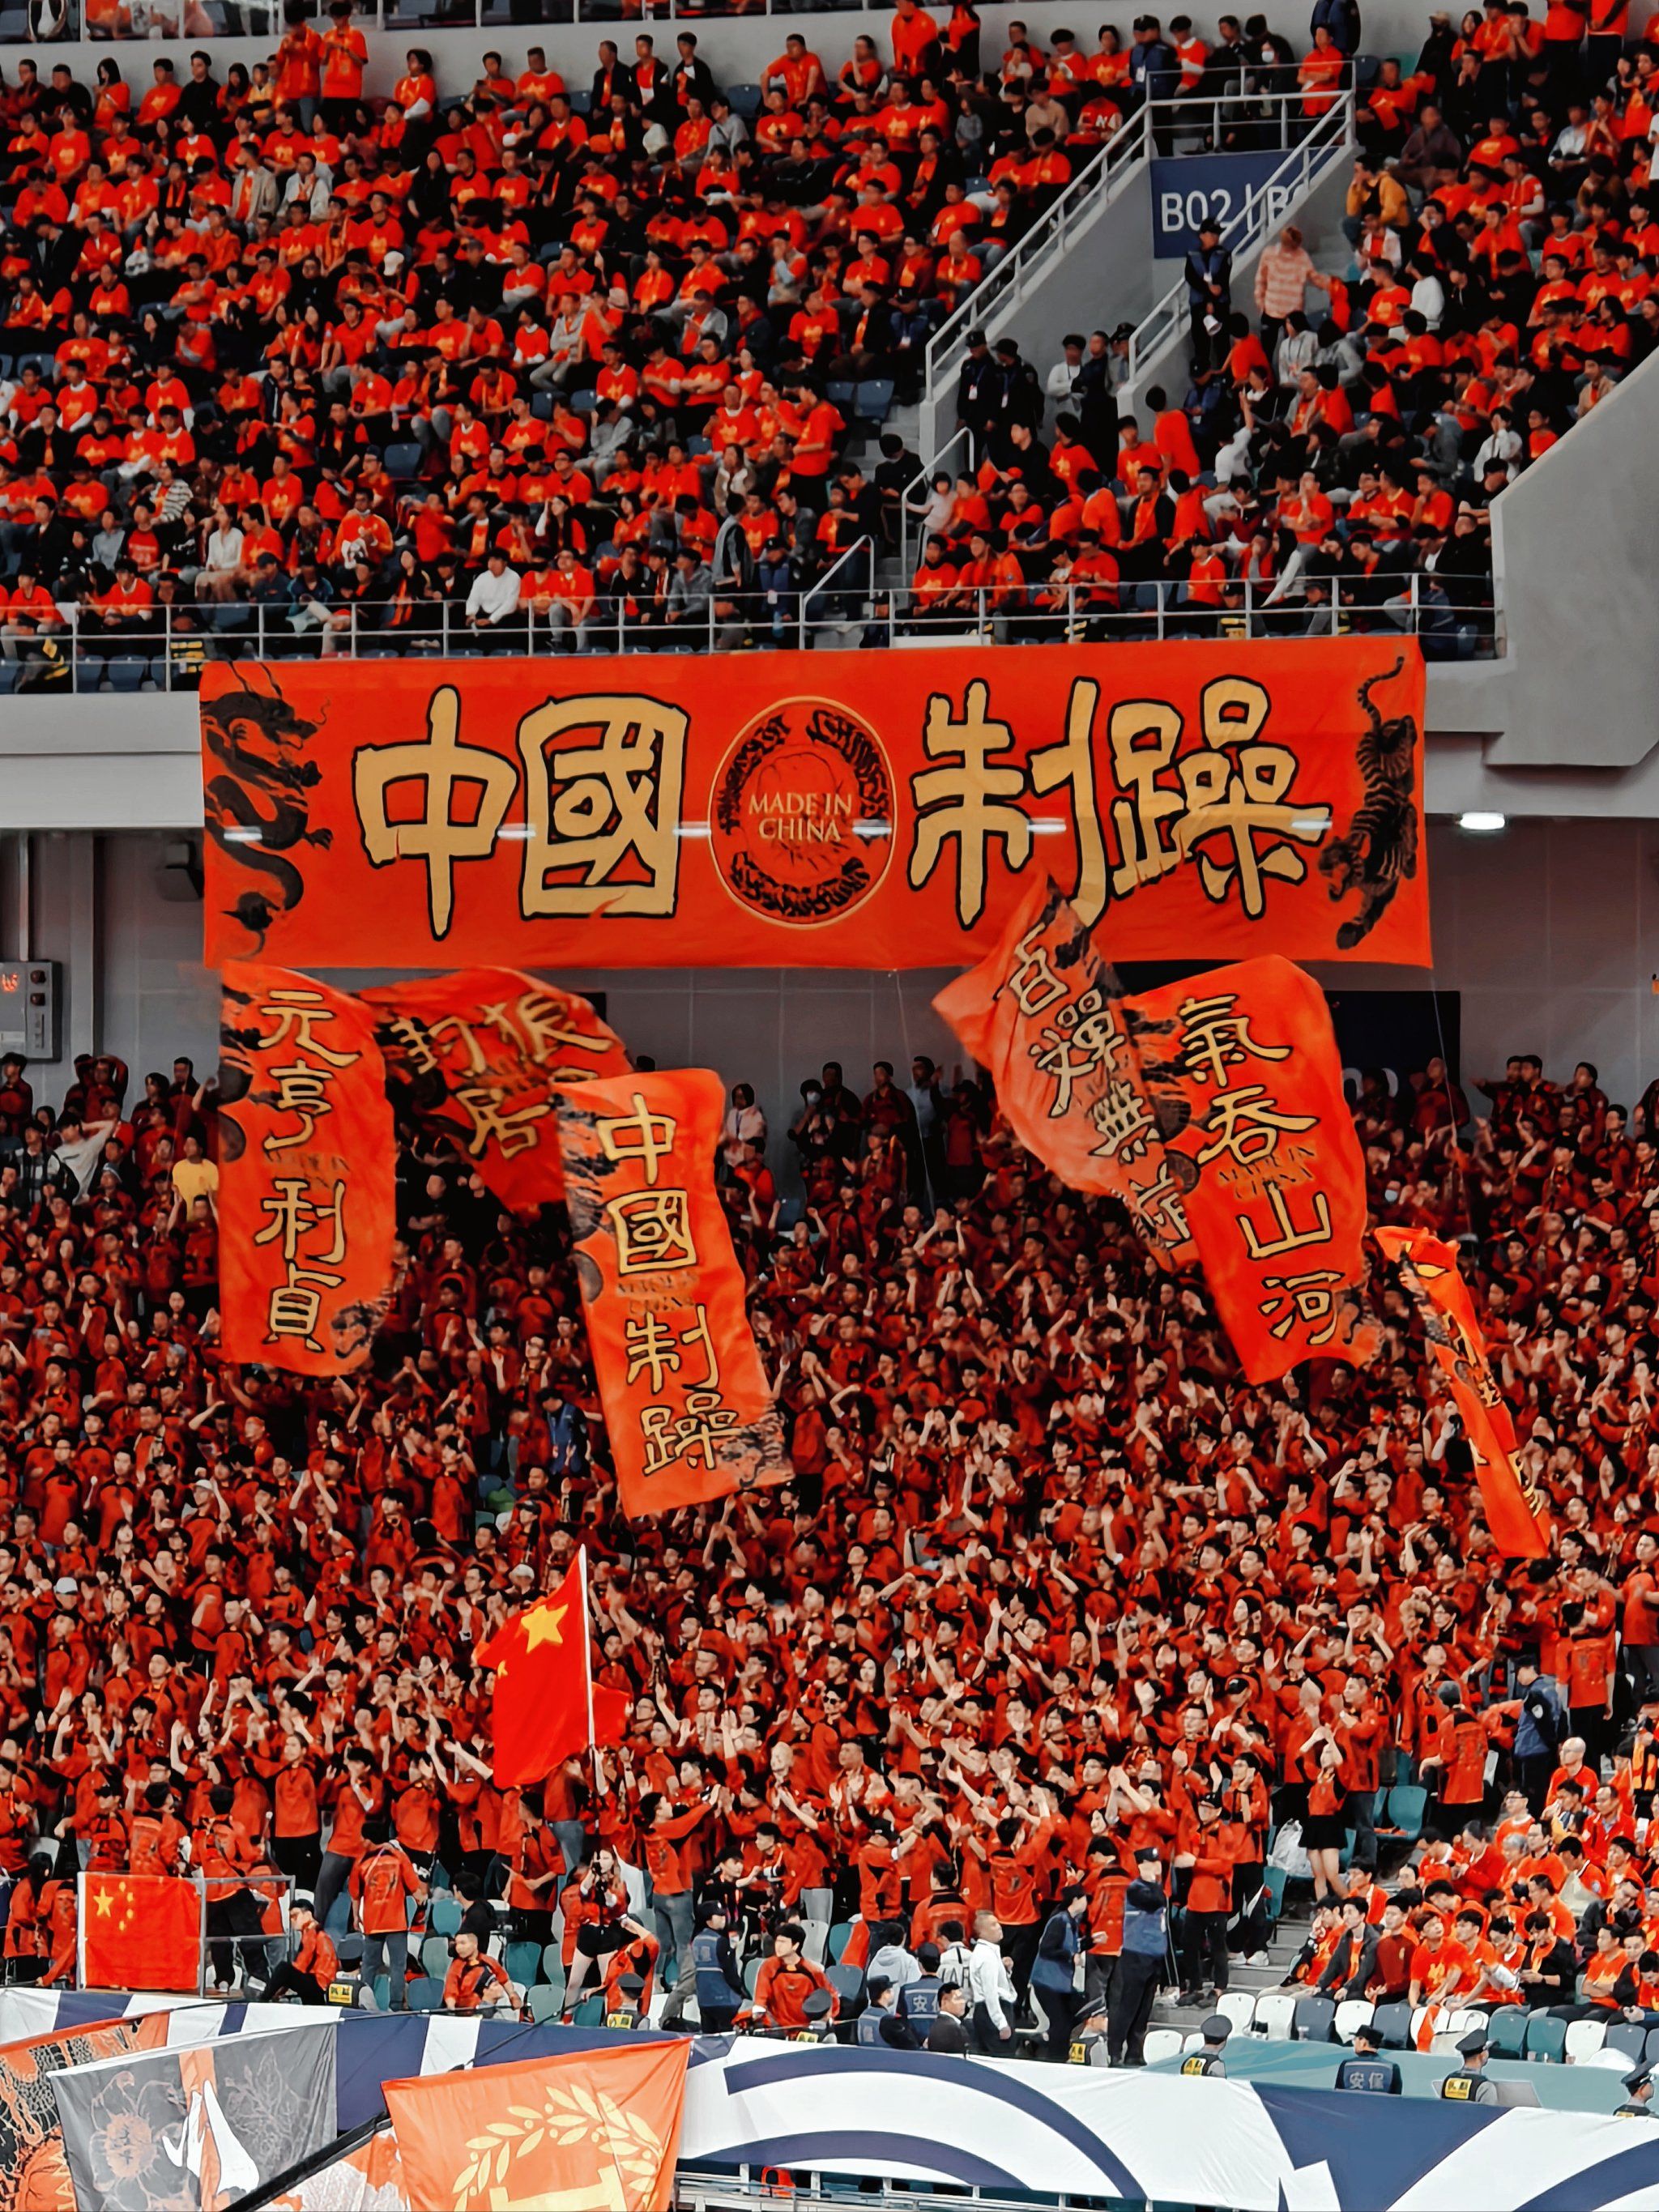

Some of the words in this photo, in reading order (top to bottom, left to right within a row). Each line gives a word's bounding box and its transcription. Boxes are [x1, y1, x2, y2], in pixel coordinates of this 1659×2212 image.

[352, 683, 690, 942] 中國
[906, 673, 1333, 931] 制躁
[748, 792, 817, 816] MADE
[824, 793, 852, 816] IN
[758, 817, 842, 843] CHINA
[254, 988, 362, 1353] 元亨利貞
[595, 1092, 741, 1477] 中國制躁
[1179, 993, 1346, 1345] 氣吞山河
